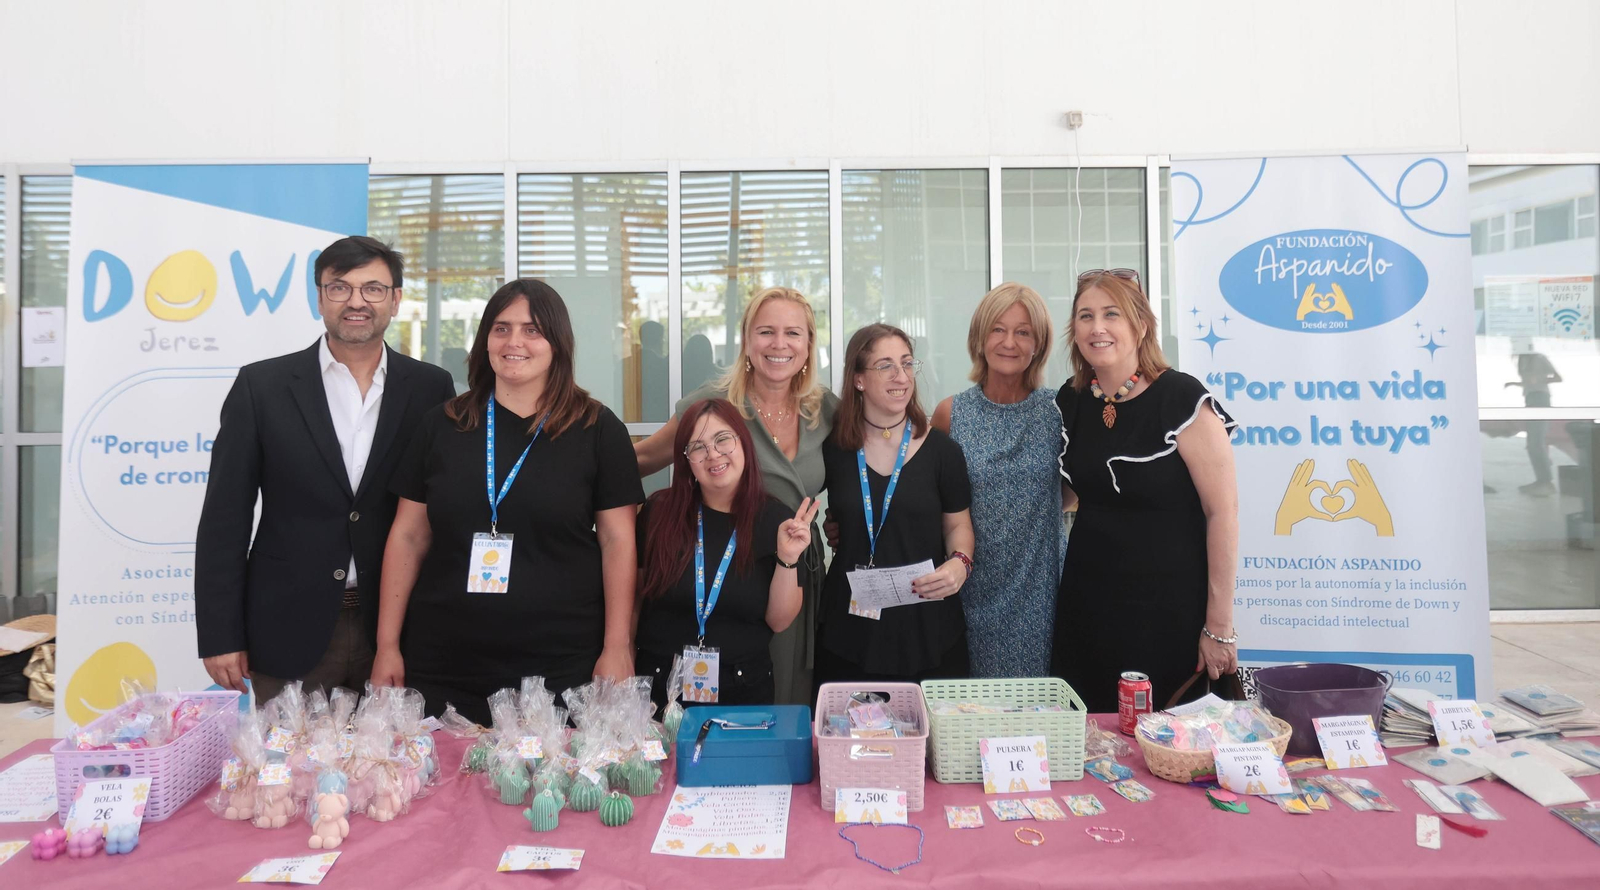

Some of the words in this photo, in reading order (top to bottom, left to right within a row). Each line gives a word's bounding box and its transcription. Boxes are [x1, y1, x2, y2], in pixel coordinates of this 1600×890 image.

[1276, 233, 1368, 249] FUNDACIÓN
[1255, 242, 1393, 299] Aspanido
[83, 250, 322, 322] DOW
[1575, 293, 1581, 301] 7
[1302, 321, 1326, 329] Desde
[1329, 321, 1348, 329] 2001
[140, 328, 220, 352] Jerez
[1206, 371, 1286, 401] “Por
[1294, 380, 1360, 400] una
[1369, 369, 1446, 401] vida
[1310, 415, 1342, 446] la
[1350, 415, 1449, 454] tuya”
[91, 434, 189, 458] “Porque
[120, 465, 148, 485] de
[1243, 555, 1336, 570] FUNDACIÓN
[1341, 558, 1421, 571] ASPANIDO
[1276, 578, 1297, 590] por
[1301, 578, 1311, 588] la
[1315, 578, 1381, 589] autonomía
[1384, 581, 1395, 592] y
[1396, 579, 1406, 590] la
[1410, 579, 1467, 590] inclusión
[69, 591, 145, 605] Atención
[1247, 597, 1302, 610] personas
[1306, 598, 1328, 608] con
[1331, 596, 1392, 608] Síndrome
[1396, 598, 1410, 609] de
[1414, 598, 1449, 609] Down
[1452, 601, 1460, 612] y
[116, 614, 144, 625] con
[1260, 614, 1339, 628] discapacidad
[1343, 616, 1409, 628] intelectual
[1394, 670, 1410, 682] 46
[1415, 670, 1430, 683] 60
[1434, 671, 1451, 683] 42
[1451, 719, 1475, 733] 1,5€
[1346, 739, 1361, 750] 1€
[1010, 760, 1024, 771] 1€
[1244, 765, 1261, 777] 2€
[94, 795, 122, 804] BOLAS
[854, 792, 888, 804] 2,50€
[93, 808, 113, 821] 2€
